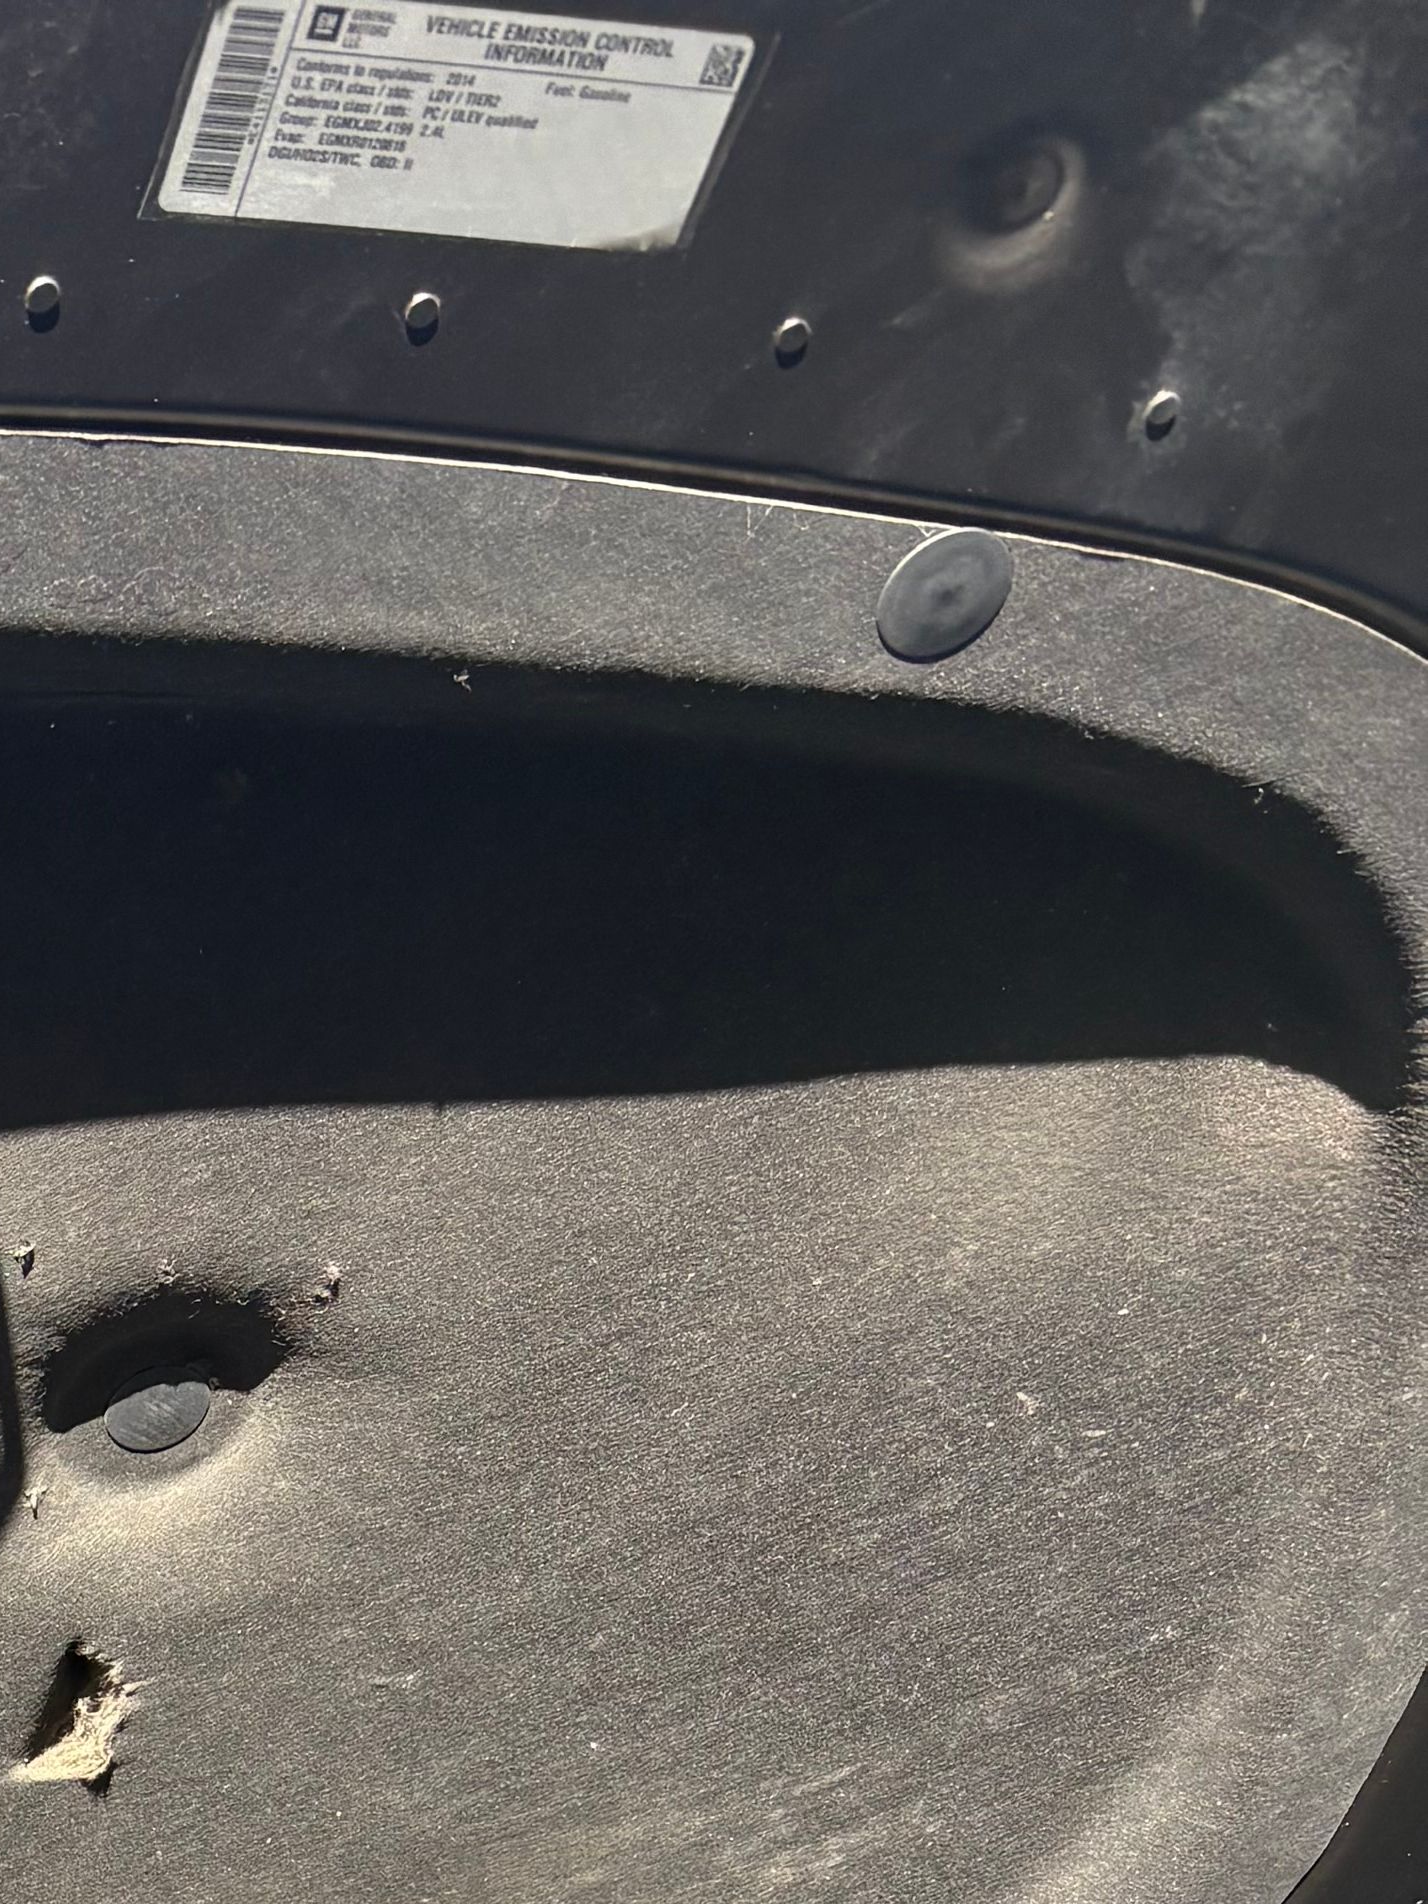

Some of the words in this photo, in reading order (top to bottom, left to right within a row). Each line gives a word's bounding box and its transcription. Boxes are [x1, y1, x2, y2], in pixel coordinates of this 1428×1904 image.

[426, 15, 498, 40] VEHICLE
[503, 23, 591, 49] EMISSION
[594, 32, 675, 58] CONTROL
[296, 57, 350, 76] Conforms
[353, 64, 365, 77] to
[446, 72, 476, 86] 2014
[484, 43, 609, 72] INFORMATION
[545, 82, 574, 98] Fuel:
[578, 84, 631, 103] Gasoline
